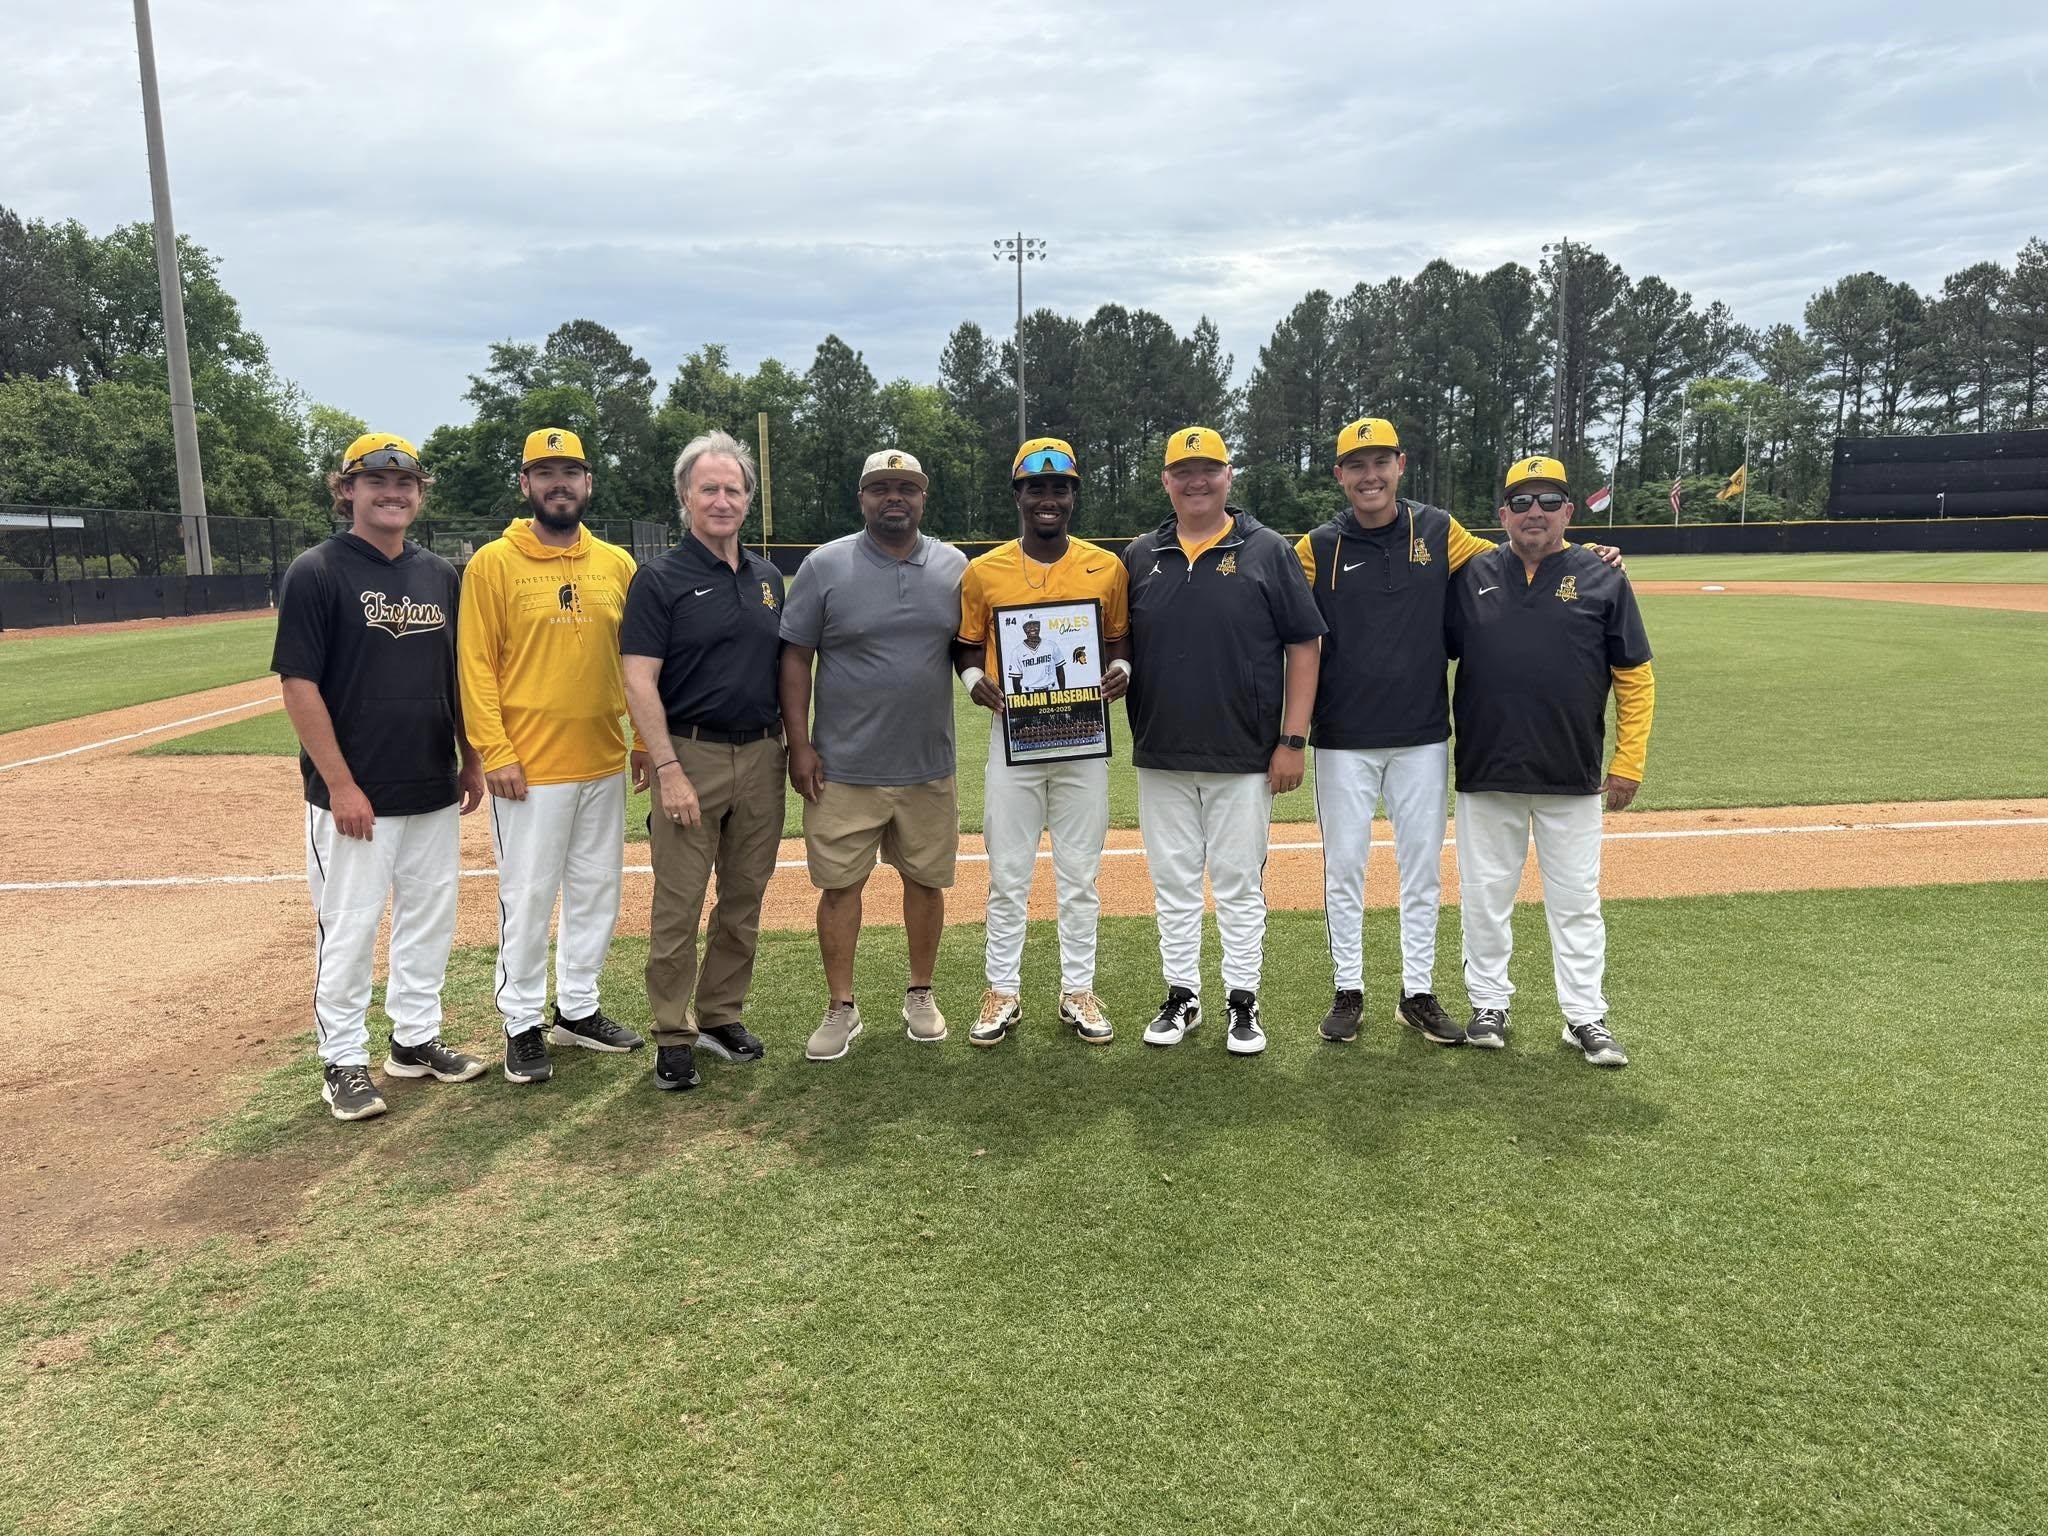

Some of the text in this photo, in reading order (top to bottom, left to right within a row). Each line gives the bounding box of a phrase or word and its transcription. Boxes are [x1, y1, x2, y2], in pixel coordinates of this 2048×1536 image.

[514, 574, 583, 585] FAYETTEVIE
[361, 591, 444, 633] Trojans
[550, 616, 593, 625] BASEALL
[1006, 617, 1017, 626] #4
[1049, 616, 1089, 629] MYLES
[1022, 654, 1052, 667] TROJANS
[1007, 688, 1101, 708] TROJAN BASEBALL
[1039, 706, 1072, 714] 2024-2025
